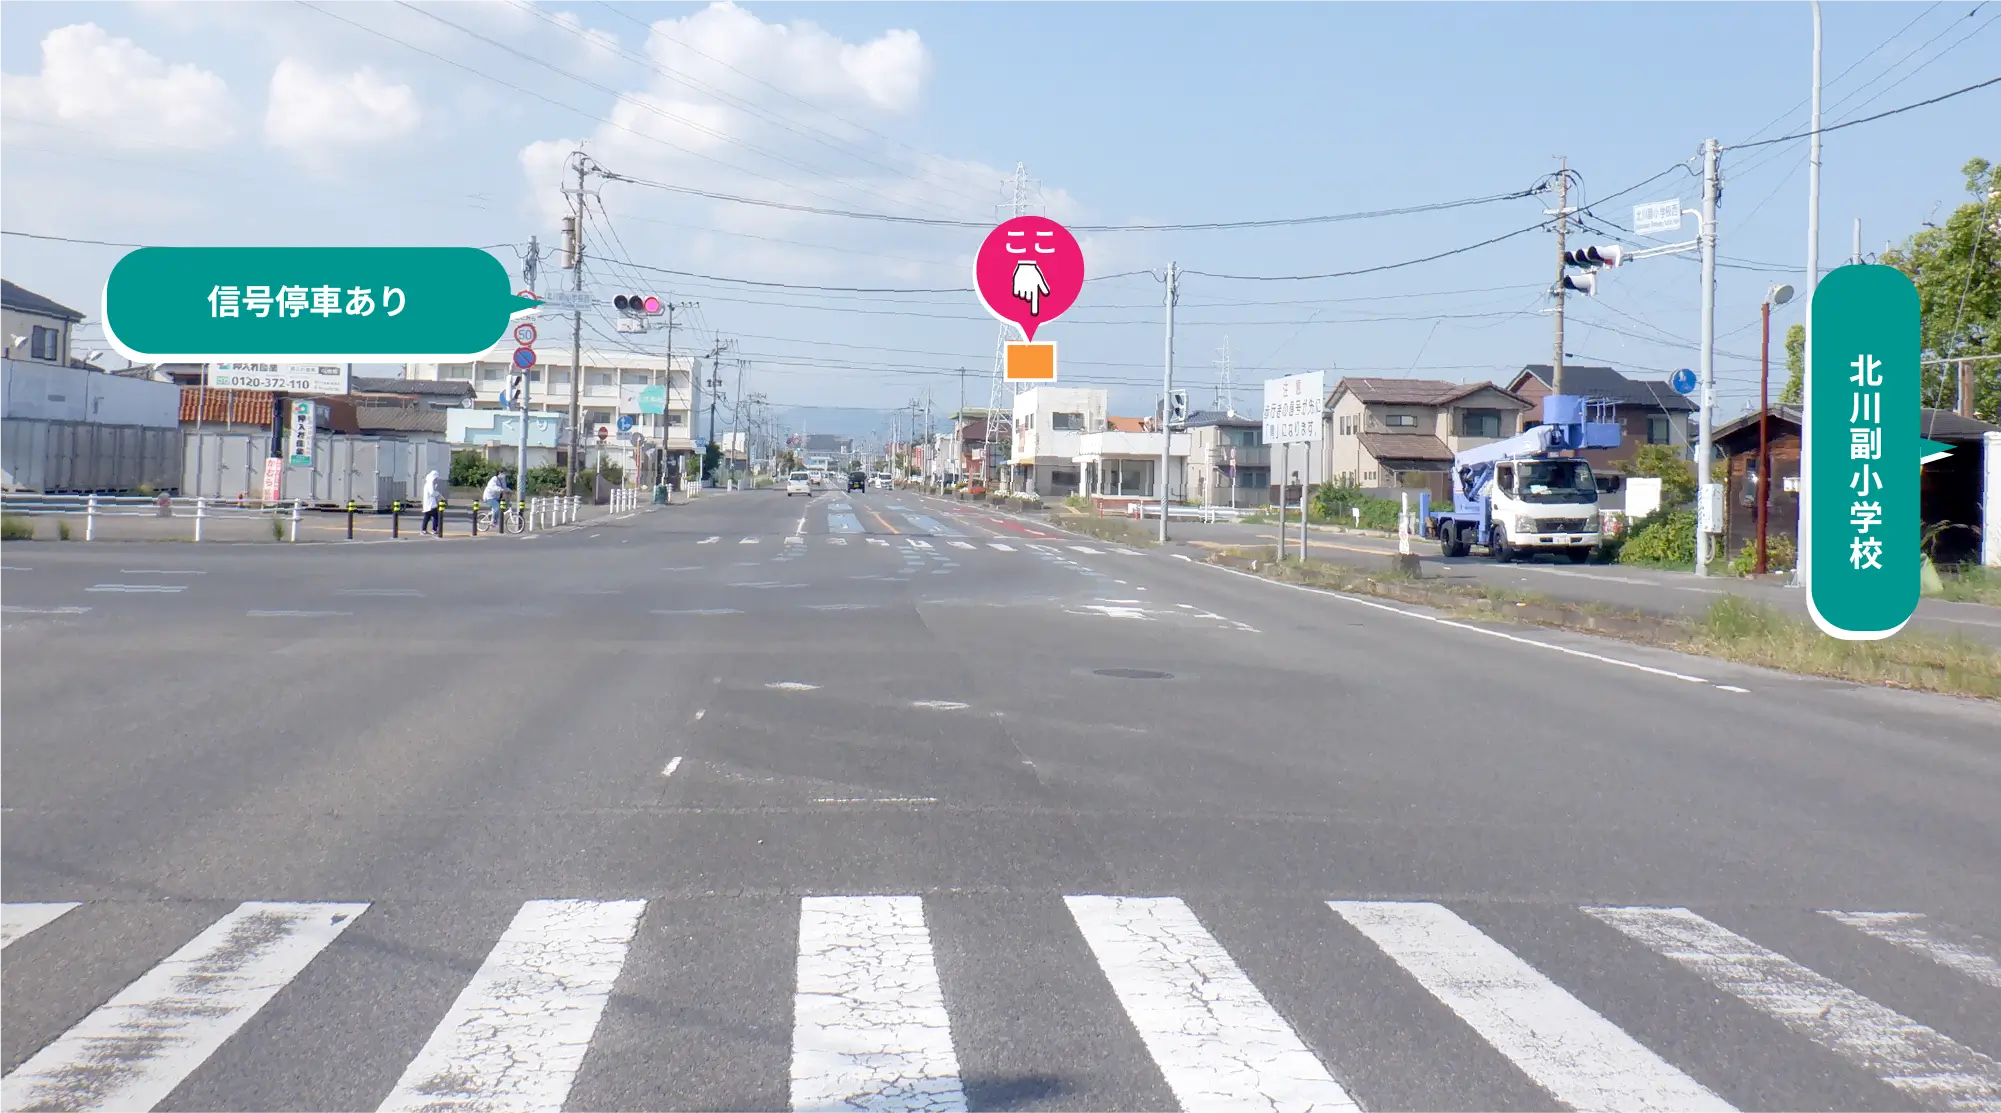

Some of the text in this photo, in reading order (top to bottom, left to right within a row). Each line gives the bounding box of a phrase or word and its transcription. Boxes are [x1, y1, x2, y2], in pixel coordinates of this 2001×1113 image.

[518, 329, 532, 341] 50
[231, 376, 310, 390] 0120-372-110
[502, 418, 549, 432] くり
